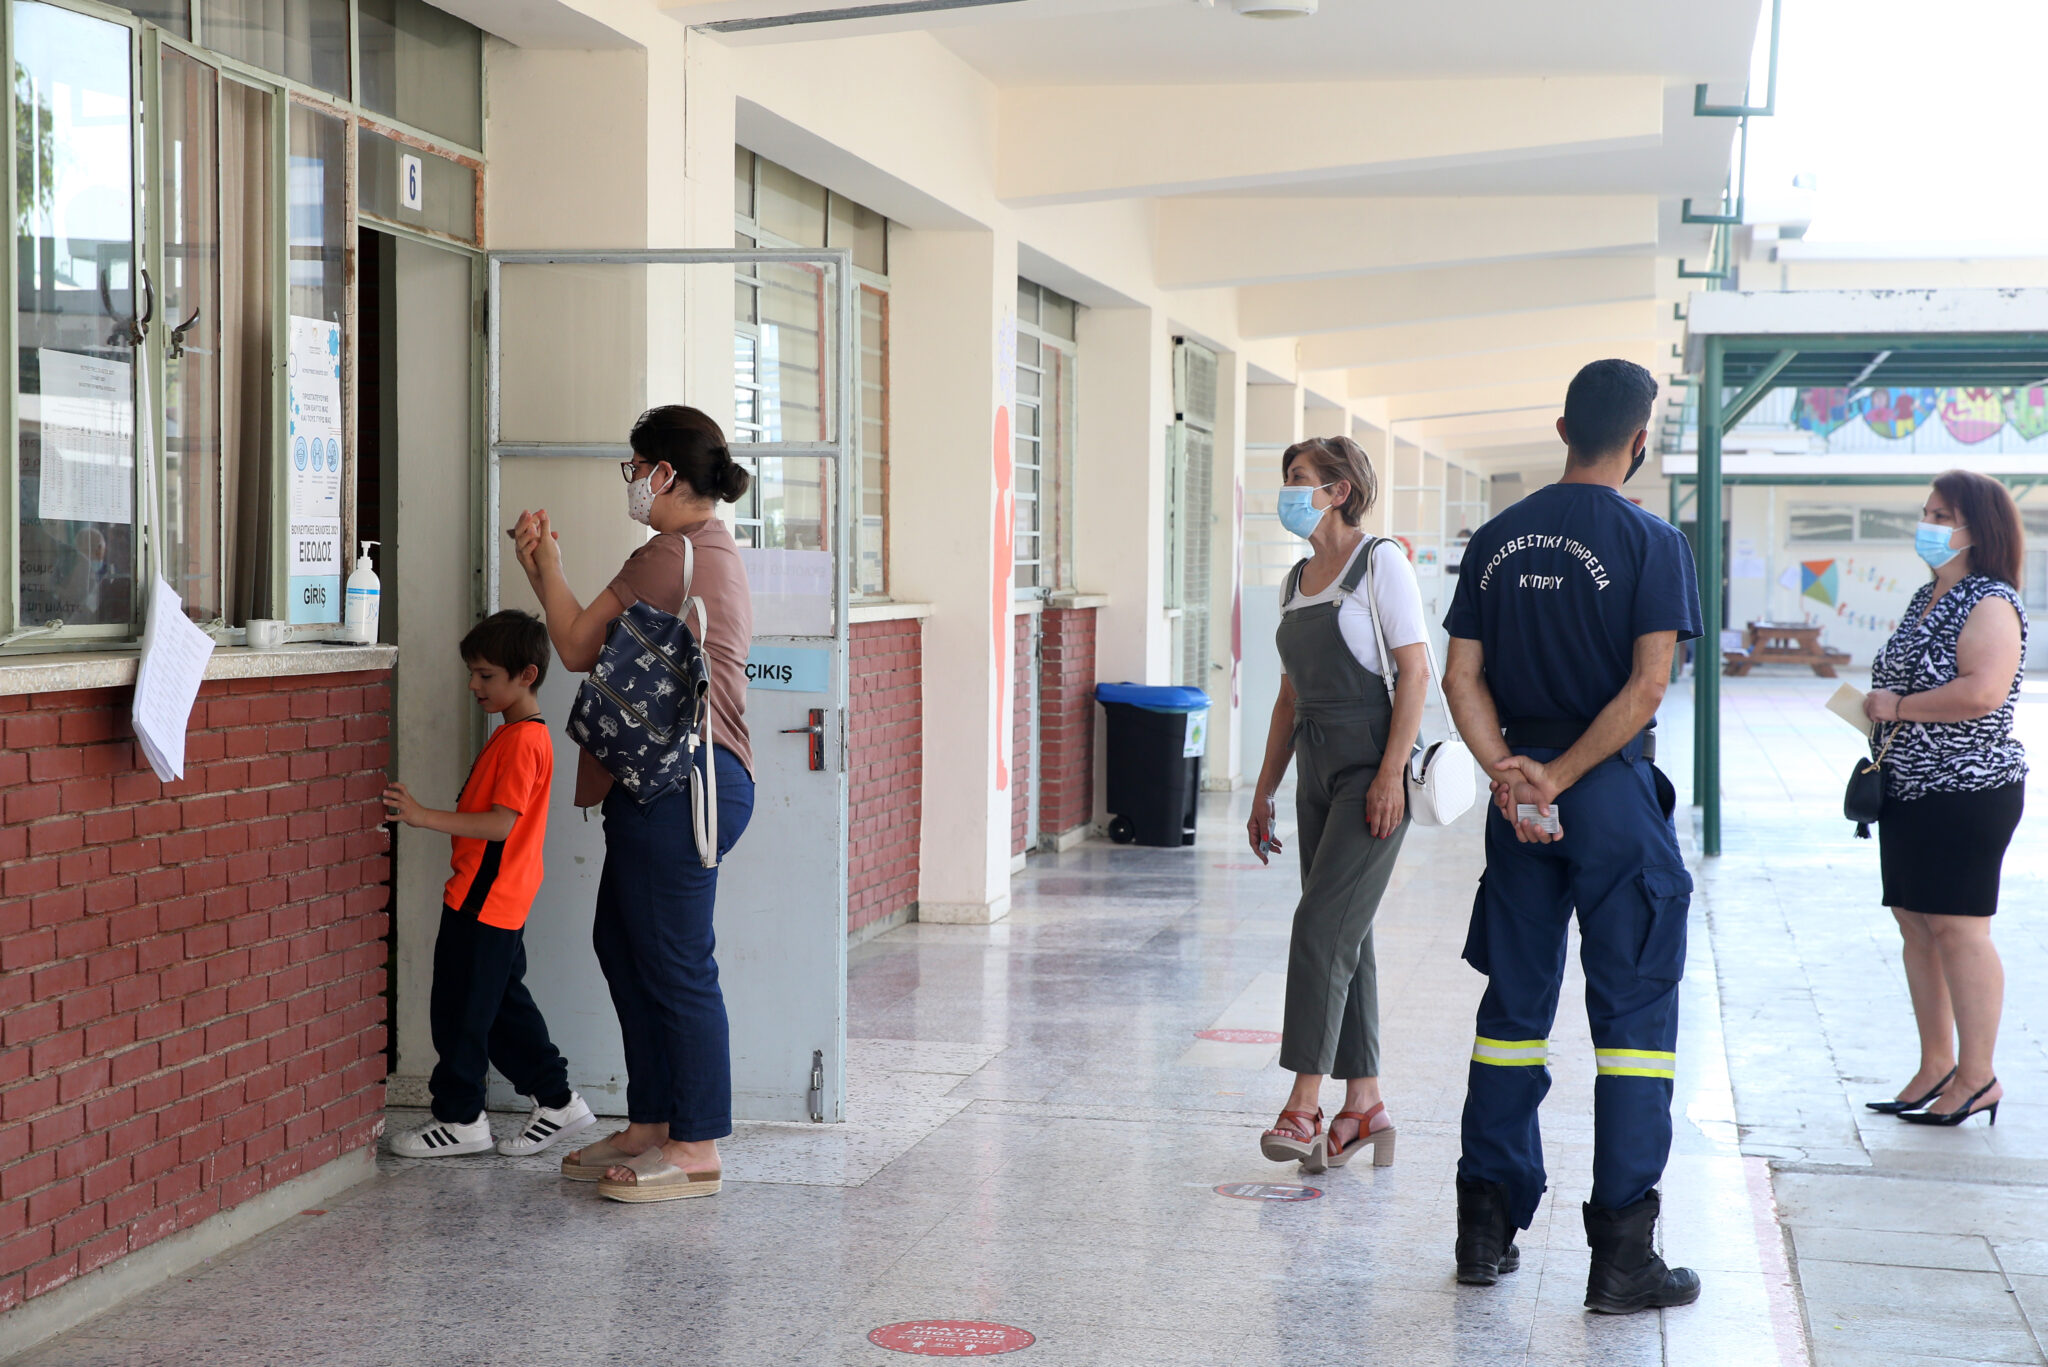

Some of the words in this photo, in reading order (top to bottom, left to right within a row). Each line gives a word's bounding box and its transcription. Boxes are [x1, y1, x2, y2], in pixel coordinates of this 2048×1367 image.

[409, 163, 416, 201] 6
[291, 524, 315, 535] ΒΟΥΛΕΥΤΙΚΕΣ
[299, 541, 332, 562] ΕΙΣΟΔΟΣ
[1564, 538, 1610, 591] ΥΠΗΡΕΣΙΑ
[1519, 574, 1564, 590] ΚΥΠΡΟΥ
[303, 584, 326, 608] GİRİŞ
[745, 663, 793, 684] ÇIKIŞ
[904, 1330, 1005, 1340] ΑΠΟΣΤΑΣΗ
[912, 1325, 1006, 1335] ΚΡΑΤΑΜΕ
[935, 1337, 1001, 1345] DISTANCE
